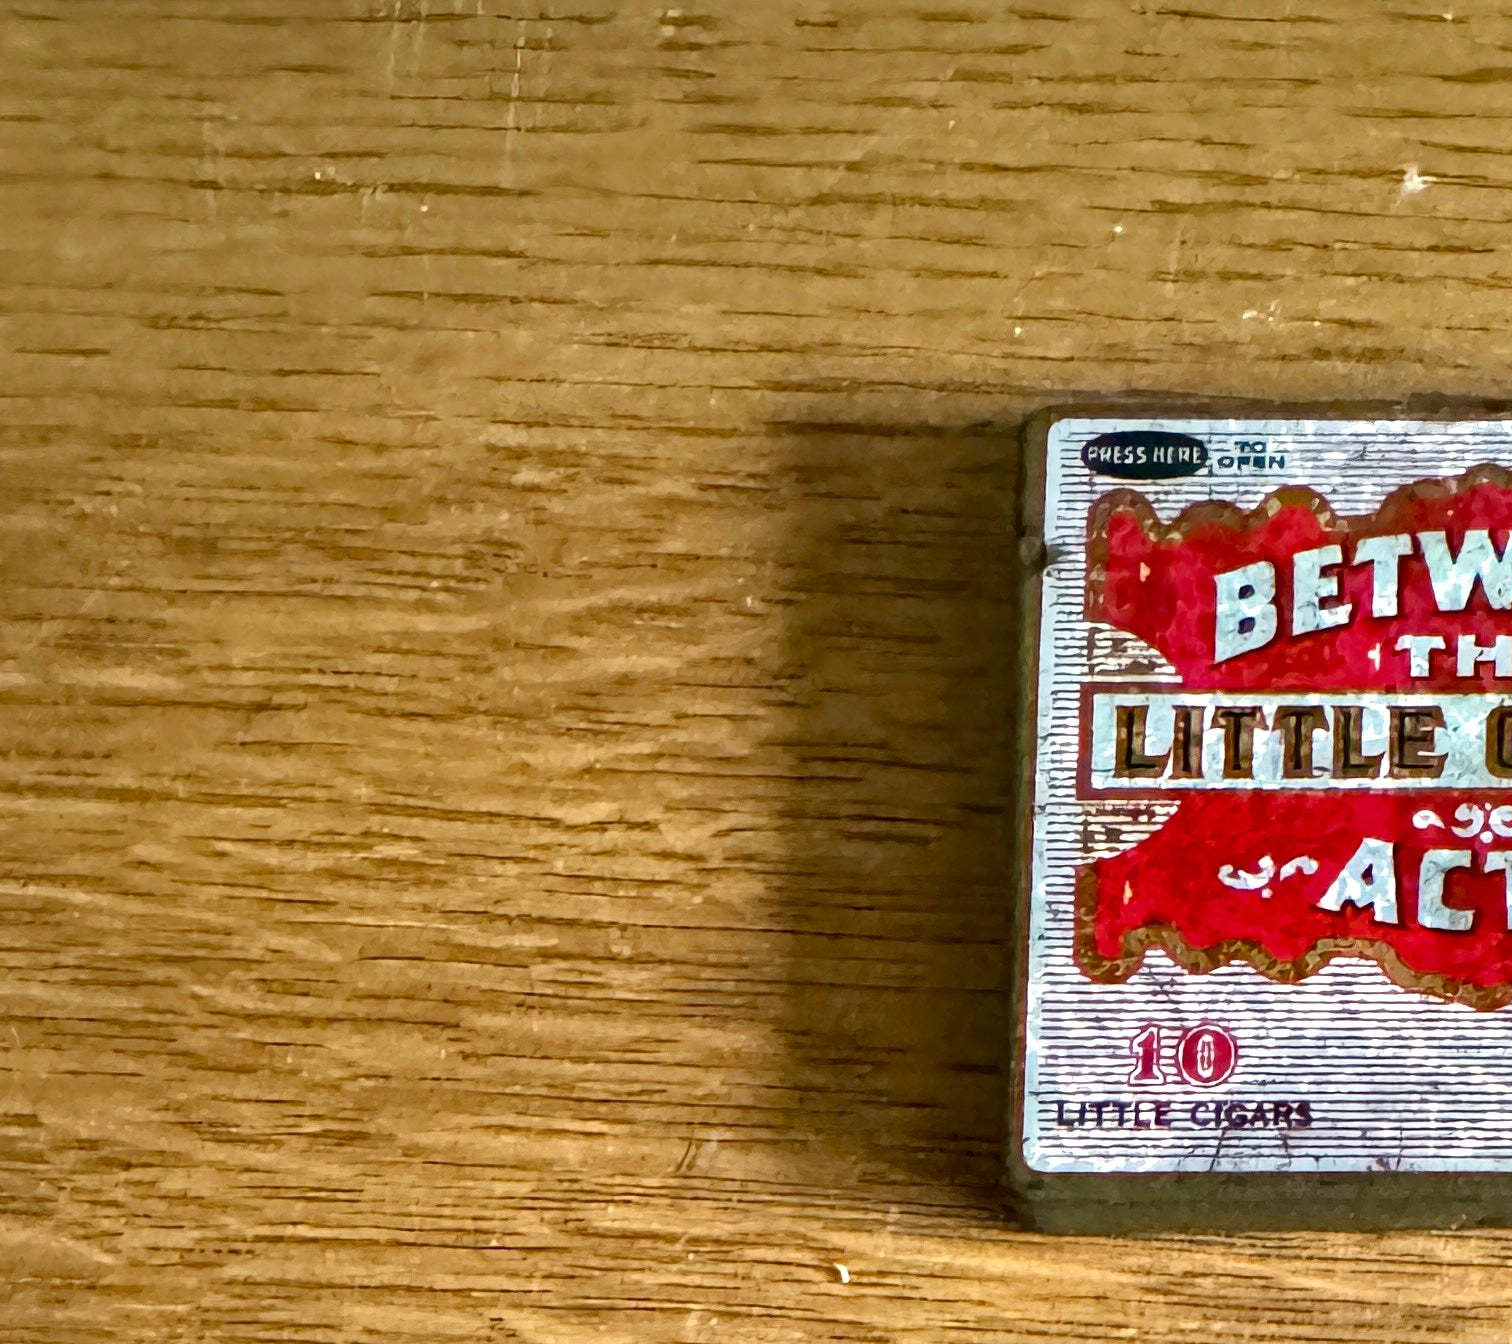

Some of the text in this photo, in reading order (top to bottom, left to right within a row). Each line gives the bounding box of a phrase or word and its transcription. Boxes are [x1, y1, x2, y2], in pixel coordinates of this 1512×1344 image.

[1087, 445, 1202, 465] PRESS HERE
[1234, 441, 1267, 453] TO
[1216, 456, 1287, 471] OPEN
[1114, 704, 1449, 779] LITTLE
[1128, 1021, 1238, 1088] 10
[1055, 1099, 1314, 1128] LITTLE CIGARS
